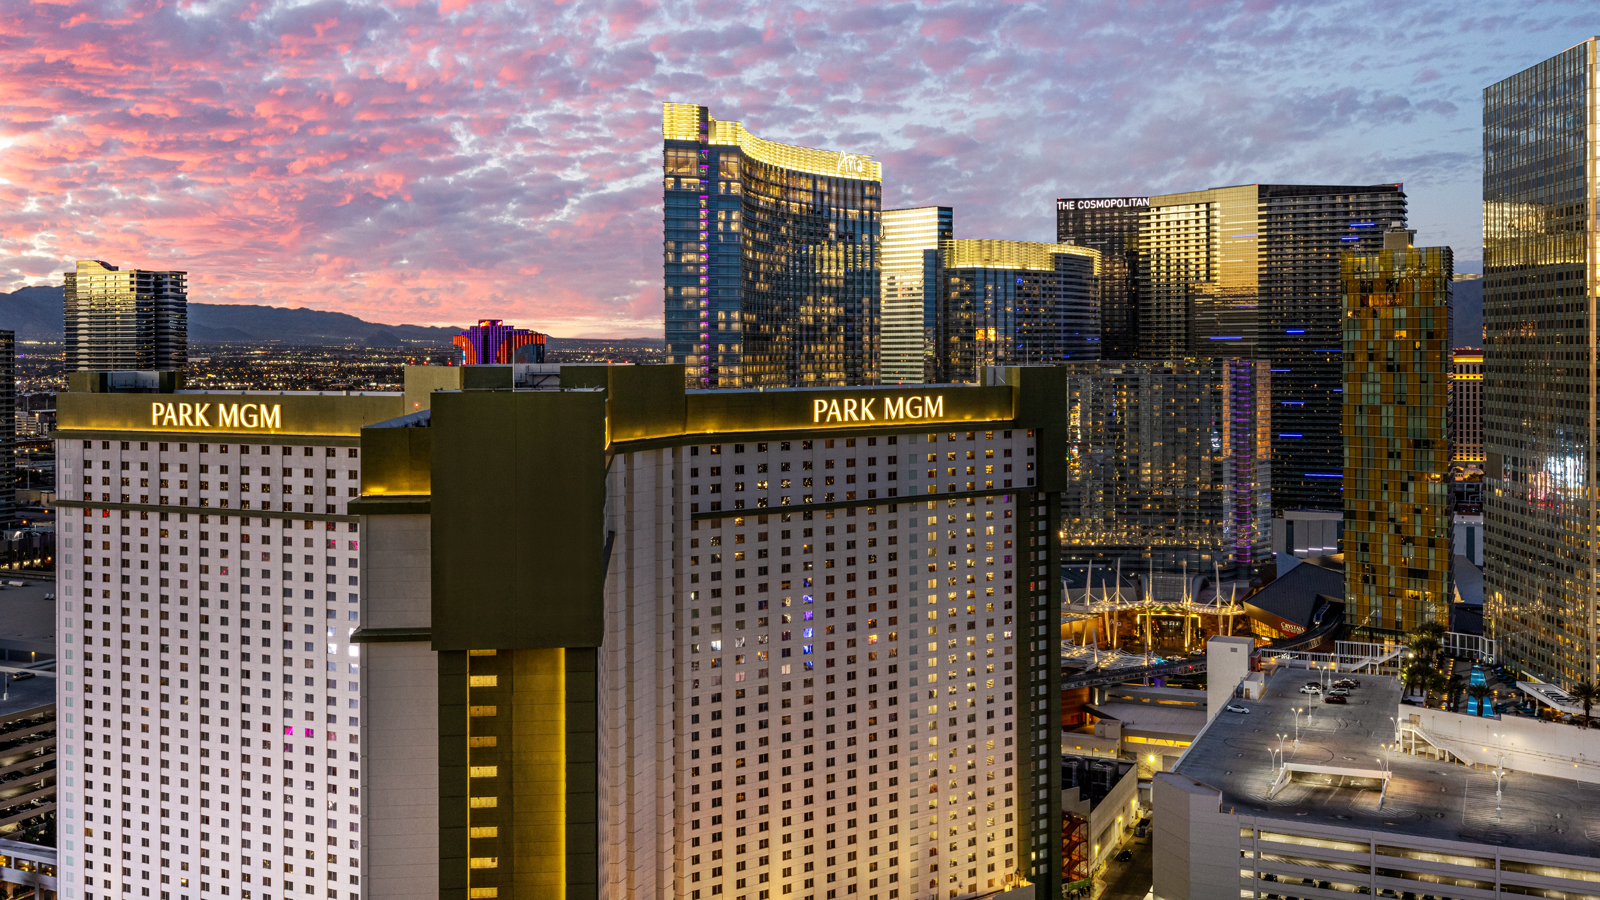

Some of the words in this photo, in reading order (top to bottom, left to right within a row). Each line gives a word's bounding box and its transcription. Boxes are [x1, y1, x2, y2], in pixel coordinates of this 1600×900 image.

[837, 150, 863, 172] Aria
[1057, 201, 1075, 210] THE
[1077, 198, 1150, 209] COSMOPOLITAN
[152, 402, 212, 427] PARK
[218, 403, 282, 428] MGM
[813, 397, 876, 422] PARK
[884, 395, 944, 420] MGM
